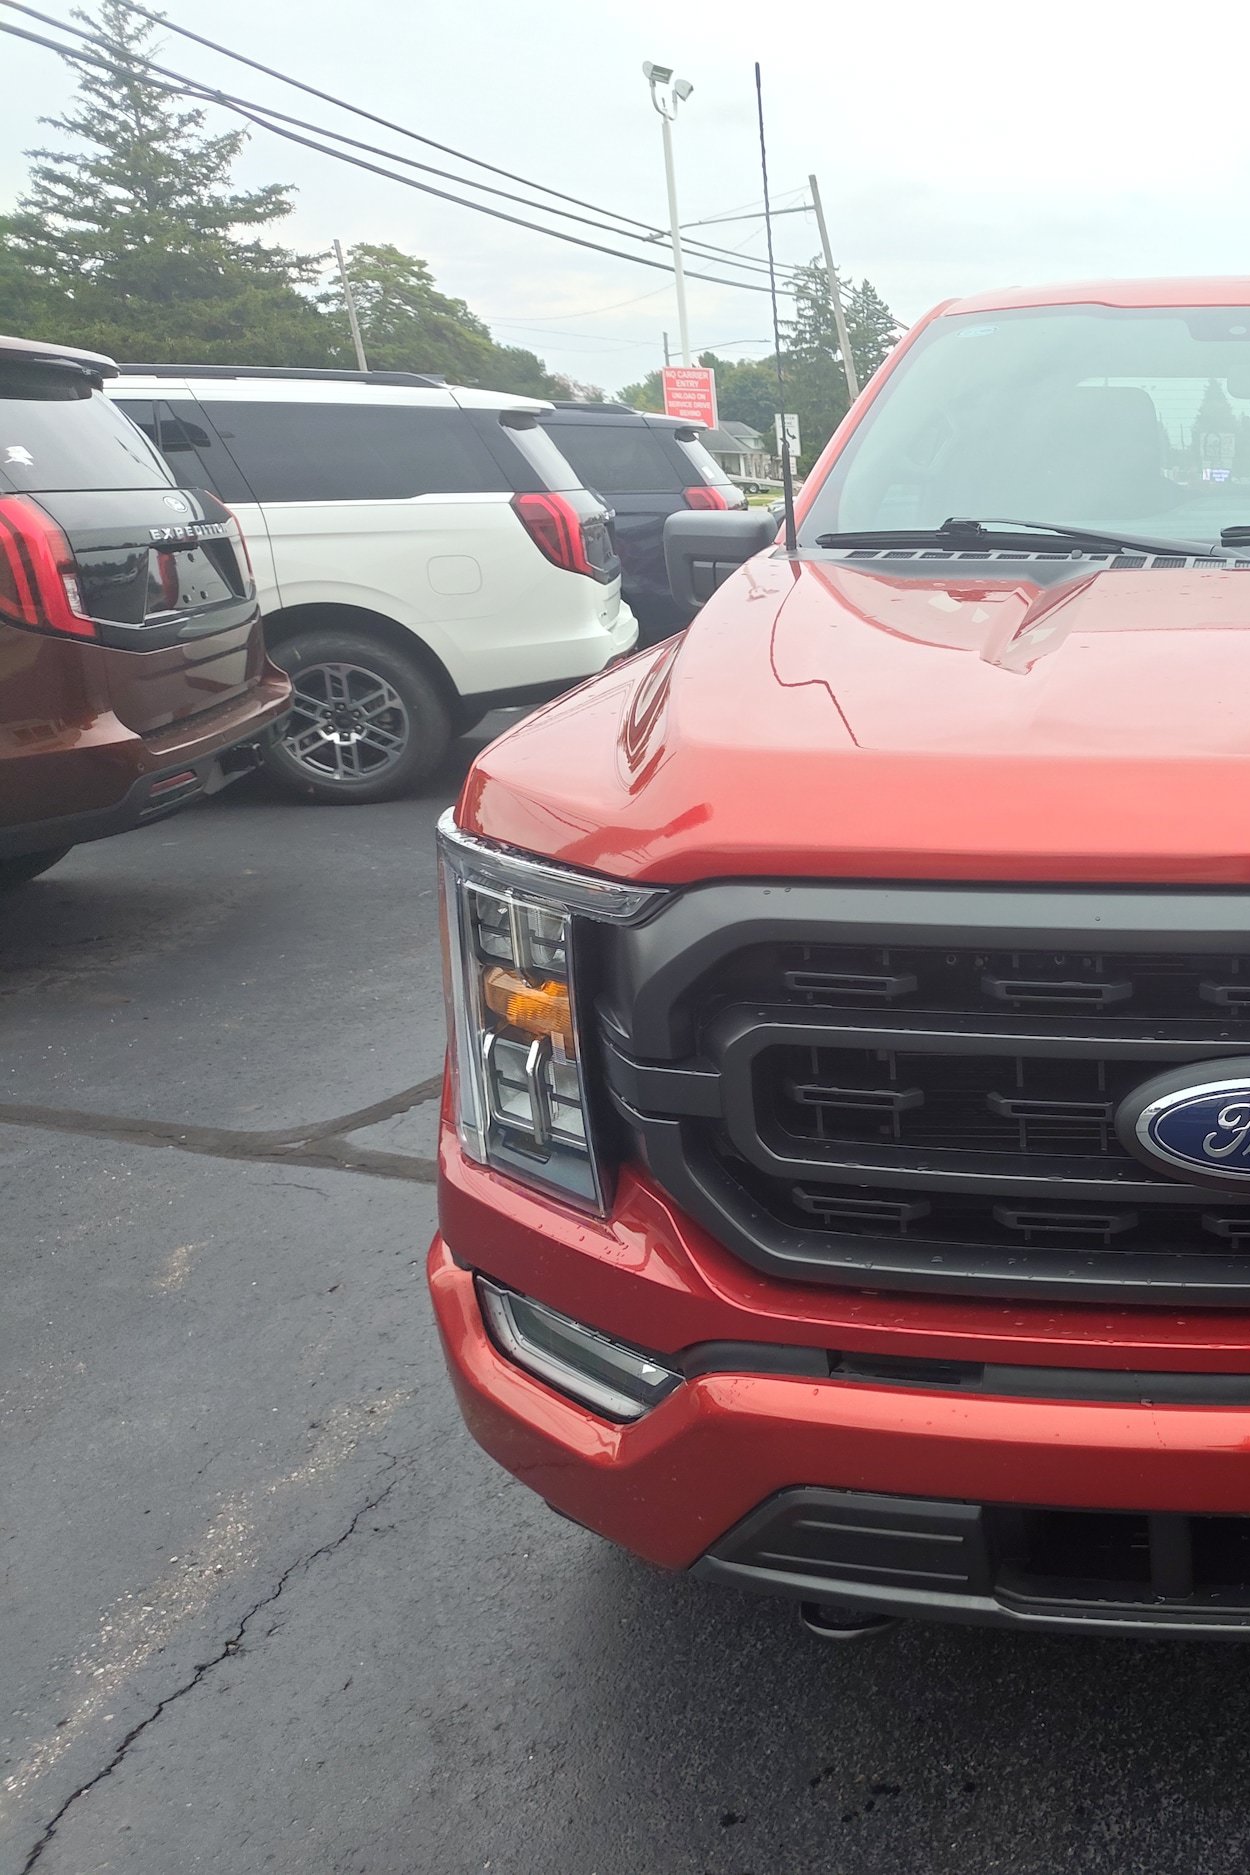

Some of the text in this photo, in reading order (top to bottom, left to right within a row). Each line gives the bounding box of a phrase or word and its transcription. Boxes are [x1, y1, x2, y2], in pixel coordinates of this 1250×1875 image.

[665, 370, 709, 380] NO CARRIER
[675, 379, 699, 388] ENTRY
[671, 392, 707, 401] UNLOAD ON
[149, 523, 228, 540] EXPEDITION
